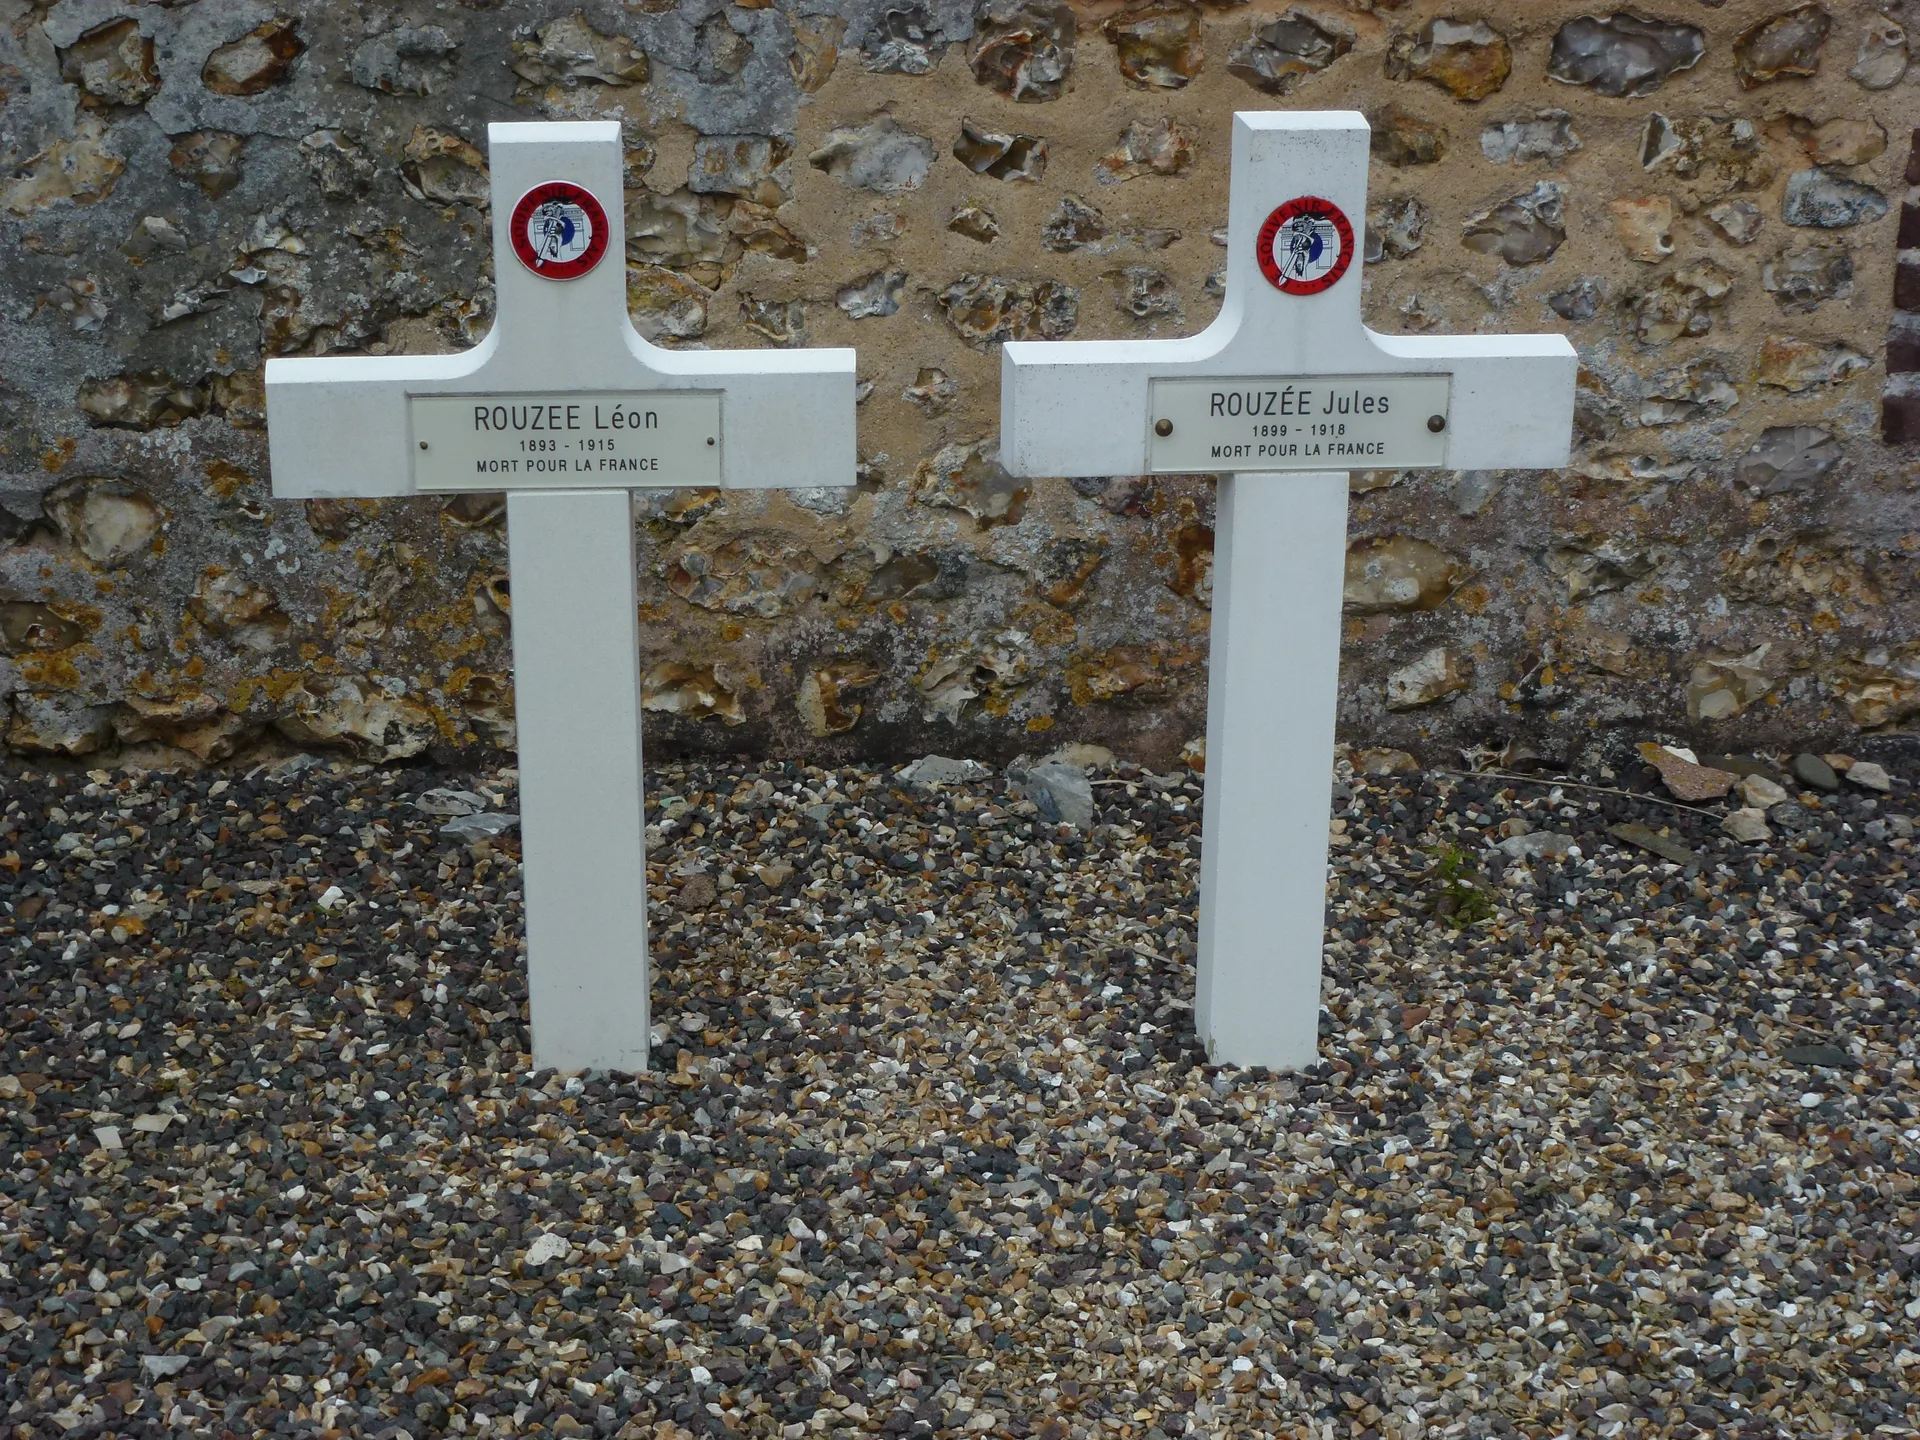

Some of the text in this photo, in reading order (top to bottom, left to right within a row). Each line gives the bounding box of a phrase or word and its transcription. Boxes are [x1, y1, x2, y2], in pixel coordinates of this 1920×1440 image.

[1260, 199, 1321, 267] SOUVENIR
[1210, 385, 1390, 417] ROUZÉE Jules
[474, 403, 658, 431] ROUZEE Léon
[1252, 424, 1288, 438] 1899
[1310, 423, 1346, 436] 1918
[519, 439, 557, 453] 1893
[578, 438, 615, 452] 1915
[1211, 442, 1385, 458] MORT POUR LA FRANCE
[476, 458, 659, 473] MORT POUR LA FRANCE
